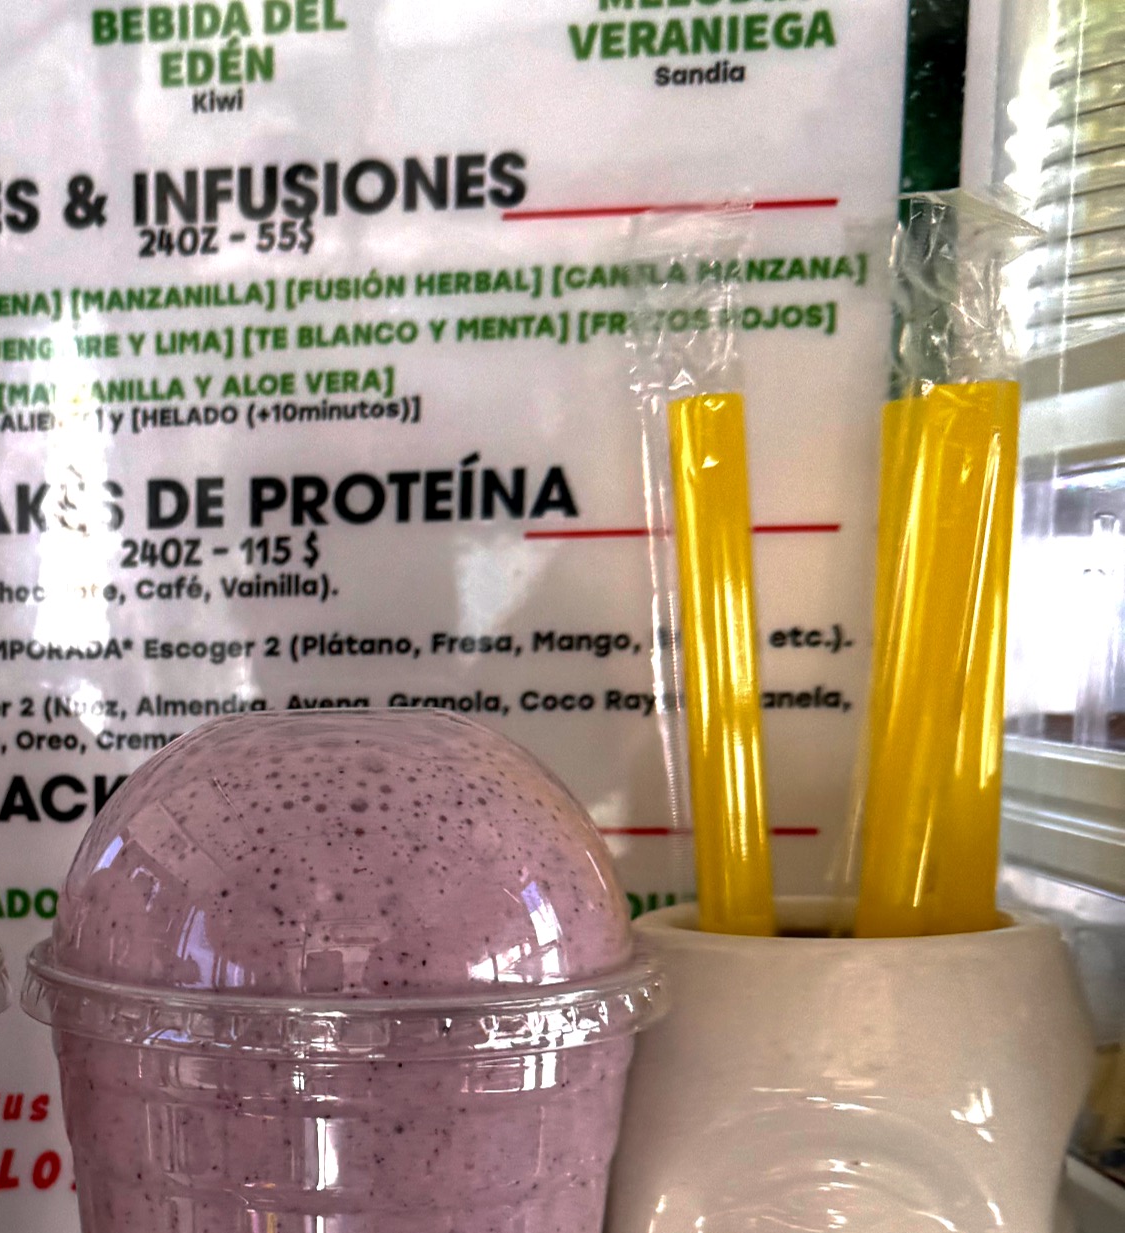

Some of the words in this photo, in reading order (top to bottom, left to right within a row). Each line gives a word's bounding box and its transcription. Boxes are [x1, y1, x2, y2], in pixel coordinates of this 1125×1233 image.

[91, 2, 251, 46] BEBIDA
[264, 0, 347, 35] DEL
[568, 10, 837, 61] VERANIEGA
[160, 36, 275, 88] EDÉN
[191, 89, 244, 114] Kiwi
[62, 173, 108, 230] &
[133, 151, 528, 228] INFUSIONES
[255, 215, 315, 254] 55$
[71, 278, 276, 322] [MANZANILLA]
[285, 268, 406, 311] [FUSIÓN
[414, 265, 543, 299] HERBAL]
[127, 331, 146, 356] Y
[155, 325, 234, 358] LIMA]
[296, 319, 419, 349] BLANCO
[429, 318, 447, 342] Y
[456, 310, 570, 344] MENTA]
[194, 374, 213, 398] Y
[221, 371, 295, 397] ALOE
[304, 365, 395, 399] VERA]
[108, 410, 125, 435] y
[131, 402, 238, 434] [HELADO
[245, 395, 422, 430] (+10minutos)]
[146, 476, 226, 531] DE
[249, 452, 581, 528] PROTEÍNA
[239, 536, 292, 567] 115
[302, 531, 321, 570] $
[134, 573, 212, 604] Café,
[219, 572, 339, 606] Vainilla).
[144, 637, 256, 664] Escoger
[262, 635, 281, 659] 2
[289, 631, 421, 663] (Plátano,
[430, 631, 522, 658] Fresa,
[532, 629, 641, 658] Mango,
[19, 696, 35, 719] 2
[520, 689, 595, 712] Coco
[760, 685, 852, 714] anela,
[15, 729, 87, 756] Oreo,
